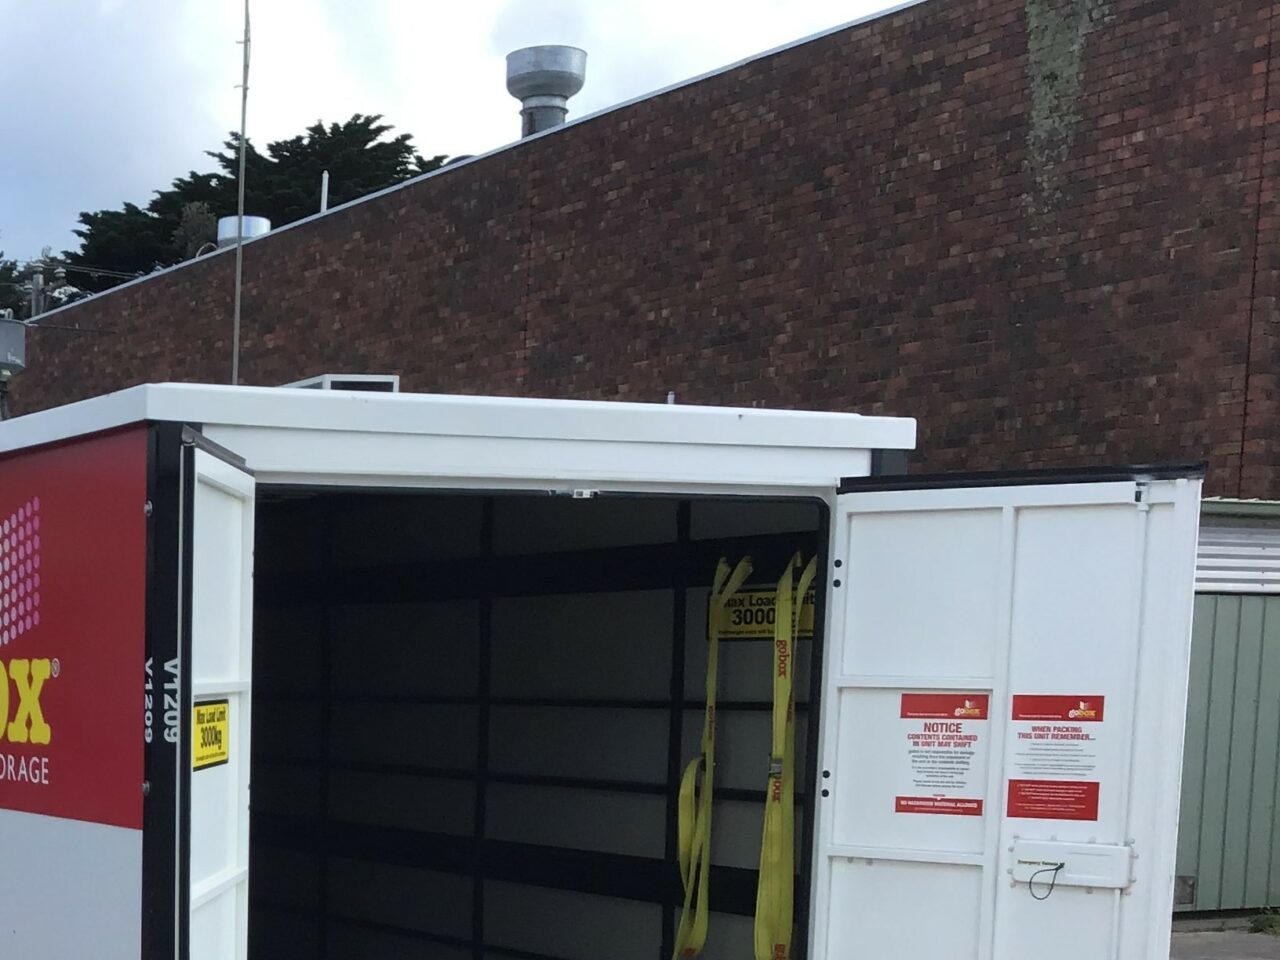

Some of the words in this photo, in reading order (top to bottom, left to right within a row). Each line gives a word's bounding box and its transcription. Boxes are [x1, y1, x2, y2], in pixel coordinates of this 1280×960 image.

[776, 639, 790, 678] gobox
[144, 657, 153, 744] V1209
[163, 657, 178, 743] V1209
[923, 722, 963, 733] NOTICE
[1031, 725, 1051, 733] WHEN
[907, 733, 940, 741] CONTENTS
[941, 734, 978, 742] CONTAINED
[1018, 732, 1033, 740] THIS
[1034, 732, 1050, 740] UNIT
